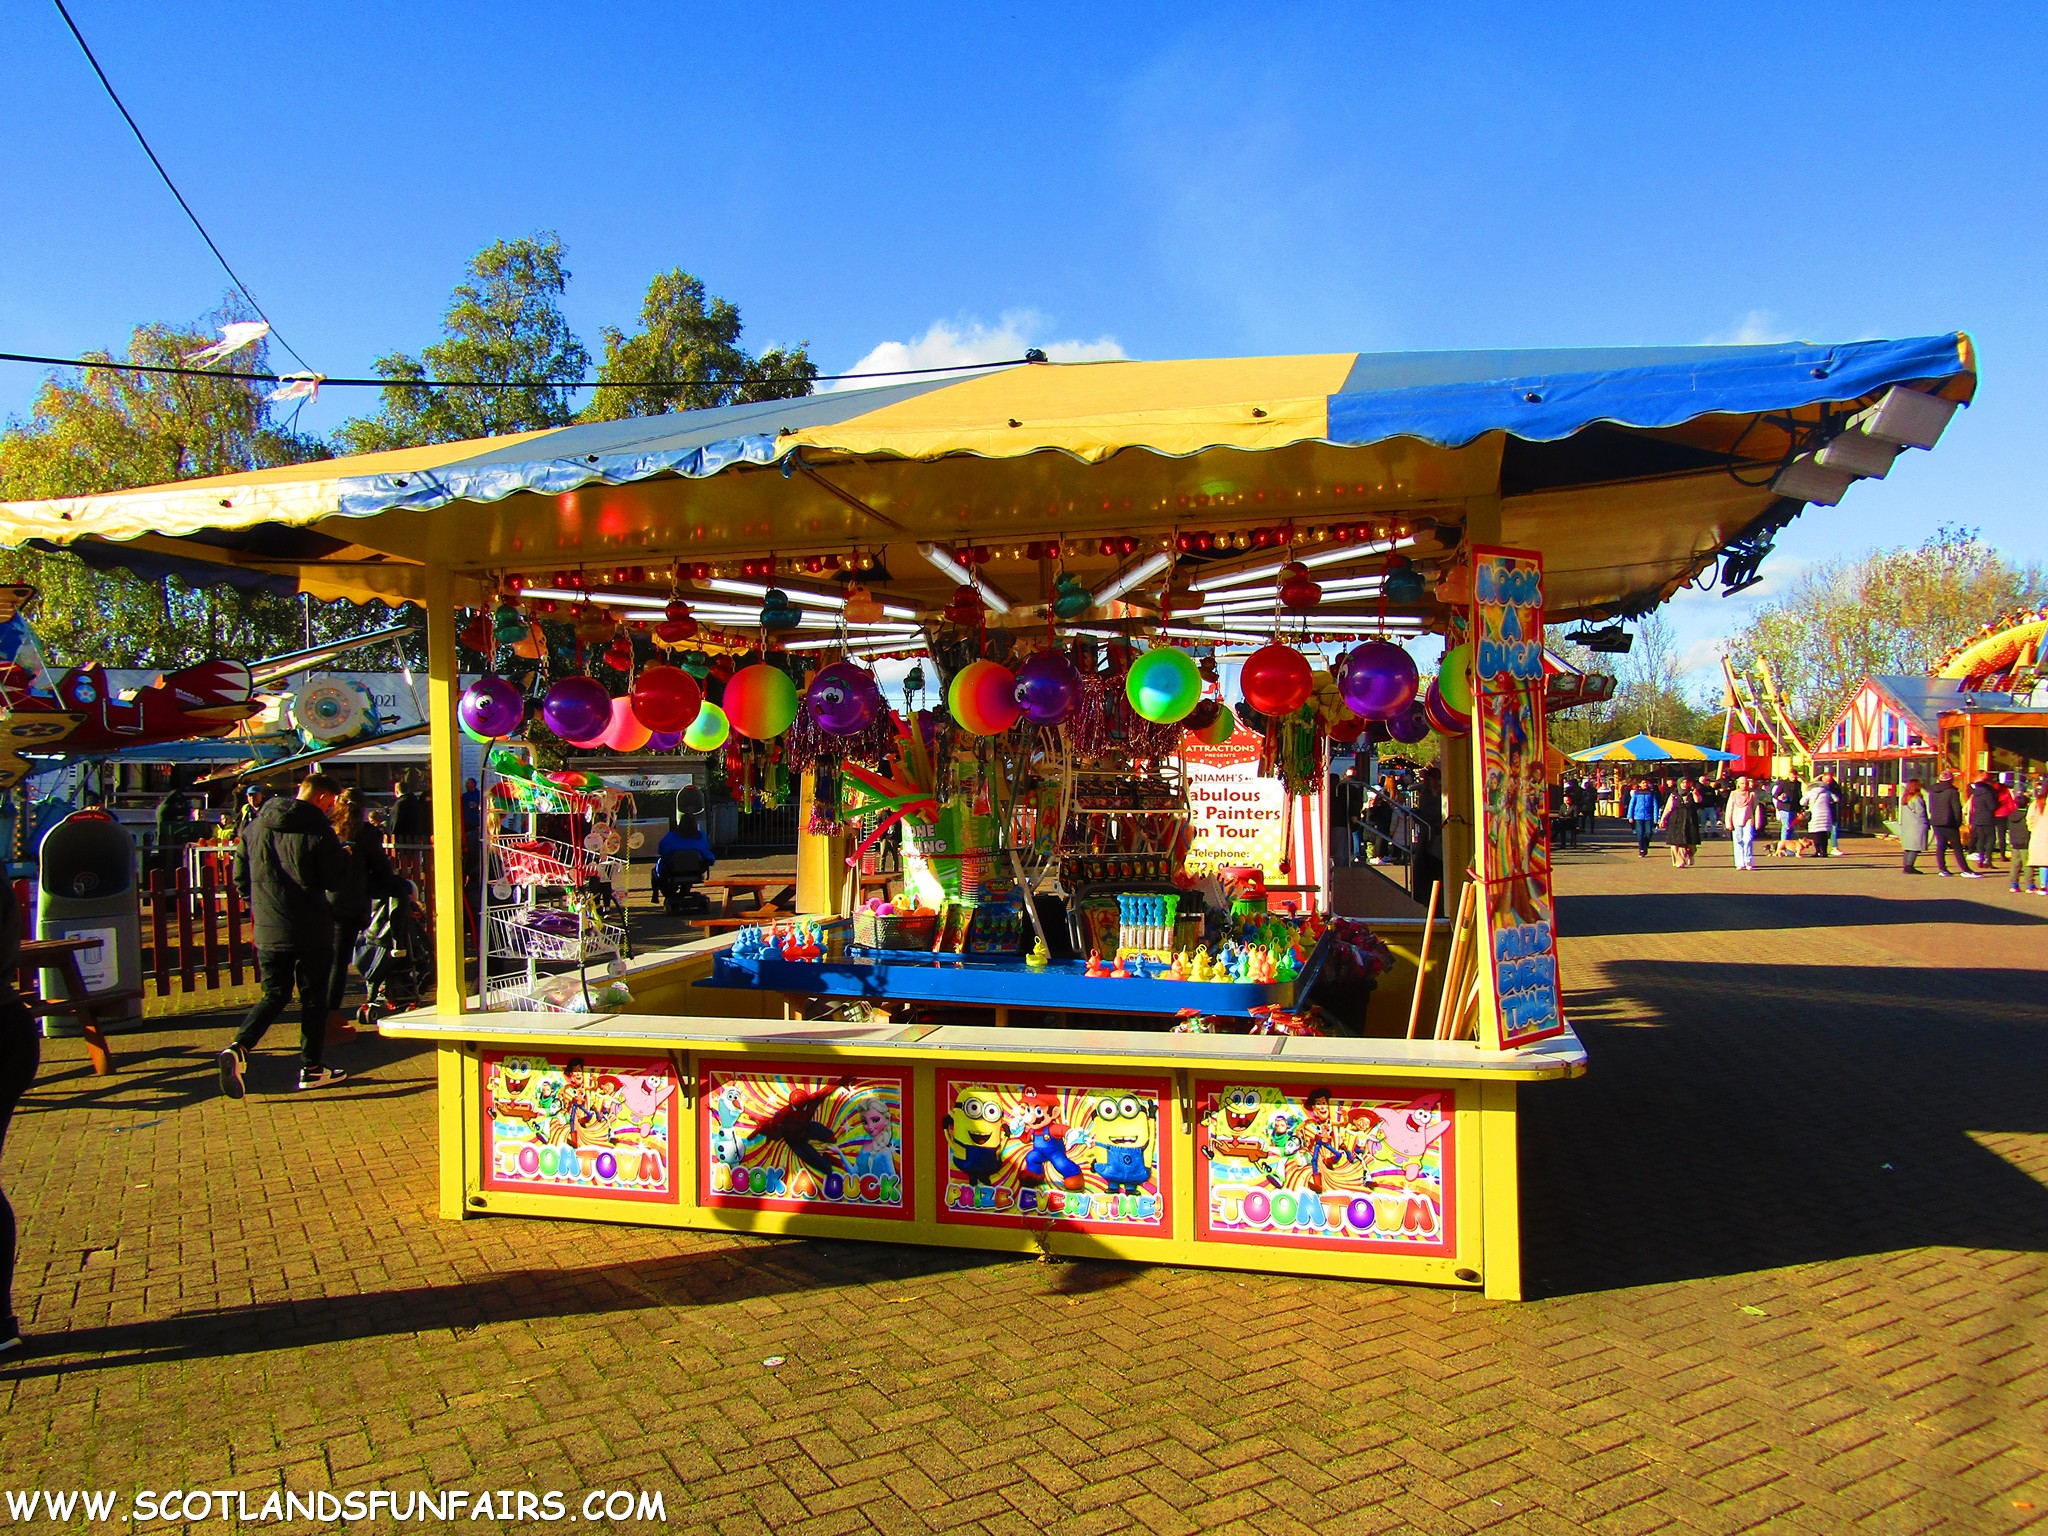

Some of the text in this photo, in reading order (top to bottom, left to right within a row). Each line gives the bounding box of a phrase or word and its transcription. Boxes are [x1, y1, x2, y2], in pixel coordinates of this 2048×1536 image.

[1476, 563, 1542, 608] HOOK
[1500, 603, 1522, 641] A
[1477, 639, 1543, 681] DUCK
[1185, 744, 1255, 753] ATTRACTIONS
[628, 778, 660, 788] Burger
[1190, 787, 1260, 802] abulous
[1194, 773, 1243, 783] NIAMH'S
[1206, 806, 1281, 820] Painters
[1216, 824, 1259, 838] Tour
[1192, 848, 1250, 859] Telephone:
[1495, 920, 1552, 961] PRIZE
[1498, 955, 1556, 997] EVERY
[1500, 987, 1557, 1031] TIME!
[497, 1142, 665, 1184] TOONTOWN
[713, 1164, 900, 1202] HOOK A DUCK
[946, 1184, 1163, 1219] PRIZE EVERY TIME!
[1214, 1186, 1437, 1235] TOONTOWN
